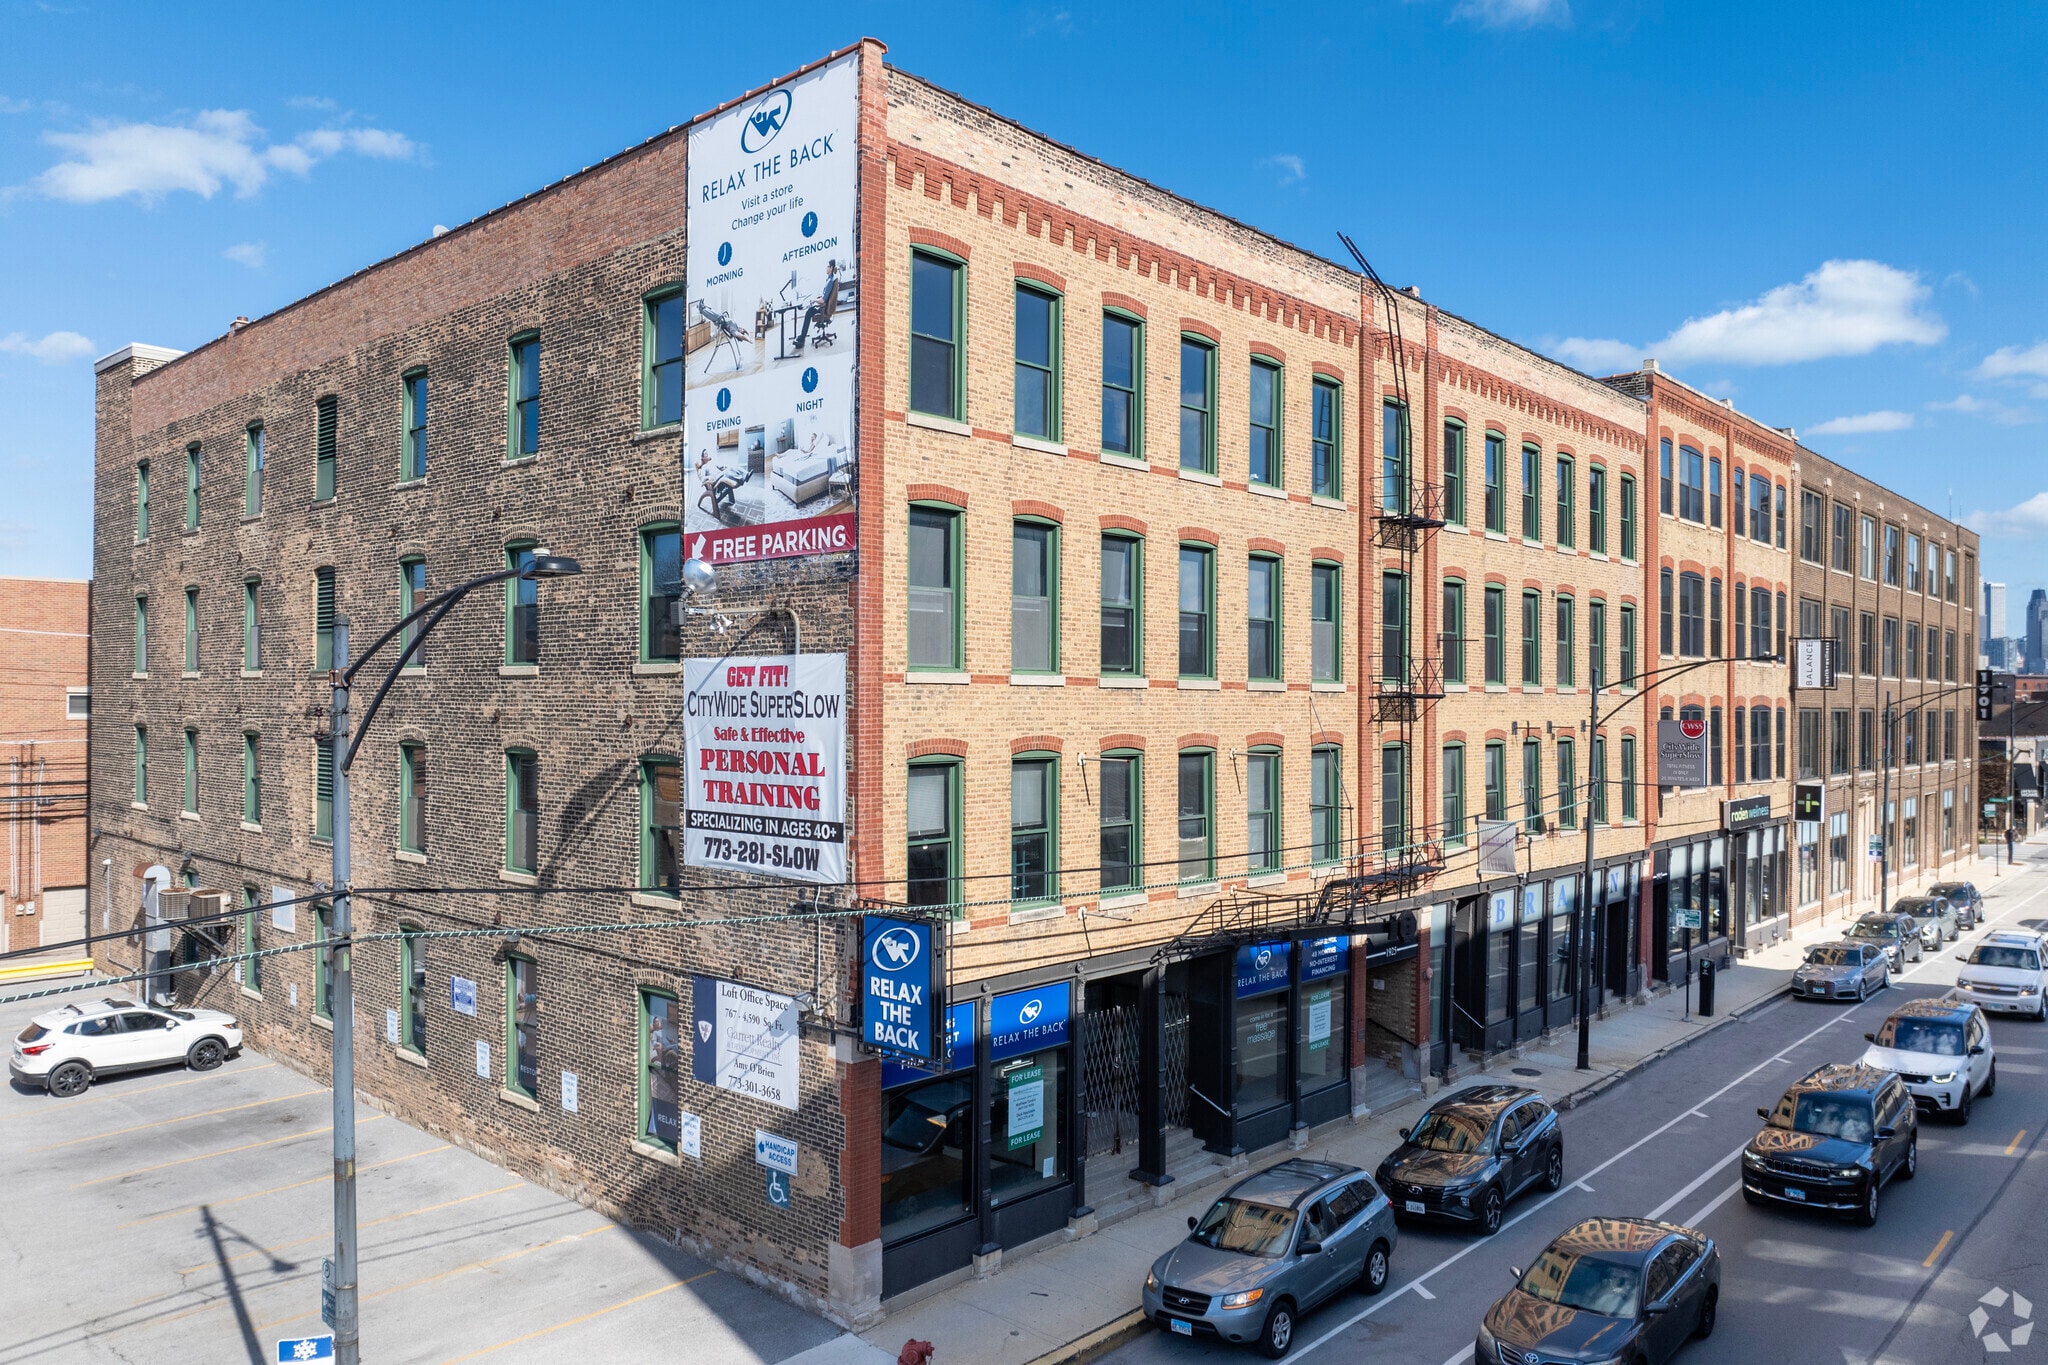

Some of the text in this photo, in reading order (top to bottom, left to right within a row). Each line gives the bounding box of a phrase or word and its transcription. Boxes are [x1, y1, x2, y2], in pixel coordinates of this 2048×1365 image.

[702, 133, 834, 203] RELAX THE BACK
[741, 183, 793, 210] Visit a store
[731, 196, 804, 231] Change your life
[782, 236, 838, 263] AFTERNOON
[706, 267, 744, 288] MORNING
[796, 398, 824, 413] NIGHT
[706, 415, 741, 432] EVENING
[713, 525, 846, 560] FREE PARKING
[727, 665, 789, 687] GET FIT!
[714, 726, 805, 743] Safe & Effective
[1682, 722, 1703, 730] CWSS
[1660, 751, 1702, 760] SuperSlow
[1662, 743, 1700, 751] CityWide
[700, 748, 825, 777] PERSONAL
[703, 779, 820, 812] TRAINING
[690, 812, 837, 840] SPECIALIZING IN AGES 40+
[704, 837, 820, 872] 773-281-SLOW
[1237, 968, 1287, 988] RELAX THE BACK
[1312, 964, 1336, 976] FINANCING
[721, 984, 789, 1011] Loft Office Space
[870, 976, 922, 1005] RELAX
[725, 1008, 737, 1018] 767
[743, 1012, 760, 1025] 4,590
[763, 1017, 774, 1031] Sq.
[775, 1019, 784, 1031] Ft.
[880, 1001, 911, 1025] THE
[875, 1021, 919, 1050] BACK
[993, 1021, 1064, 1047] RELAX THE BACK
[1256, 1022, 1267, 1032] free
[726, 1027, 781, 1054] Garrett Realty
[734, 1059, 775, 1078] Amy O'Brien
[1011, 1068, 1041, 1083] FOR LEASE
[728, 1074, 780, 1100] 773-301-3658
[657, 1114, 677, 1127] RELAX
[765, 1141, 795, 1157] HANDICAP
[1010, 1130, 1041, 1146] FOR LEASE
[769, 1152, 792, 1166] ACCESS
